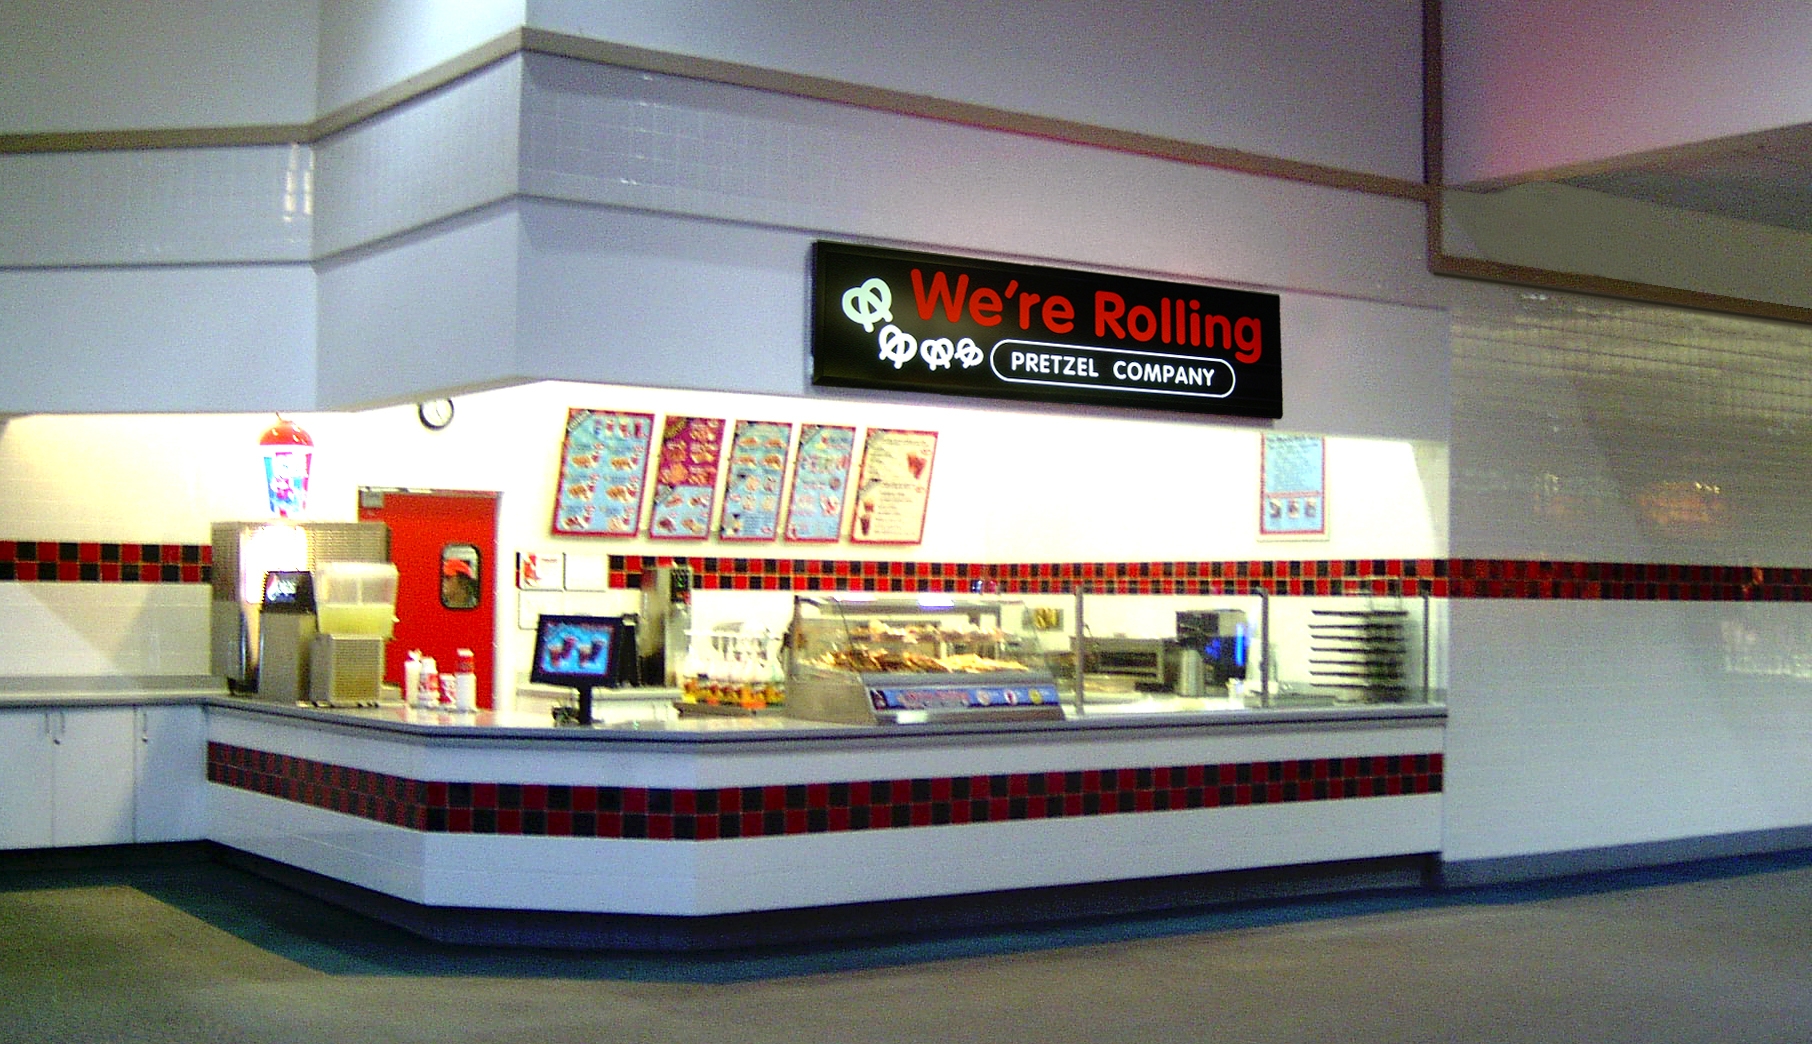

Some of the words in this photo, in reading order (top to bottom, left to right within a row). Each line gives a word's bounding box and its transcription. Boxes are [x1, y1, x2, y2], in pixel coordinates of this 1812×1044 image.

[911, 268, 1075, 334] We're
[1094, 290, 1262, 364] Rolling
[1011, 351, 1099, 378] PRETZEL
[1112, 360, 1215, 387] COMPANY
